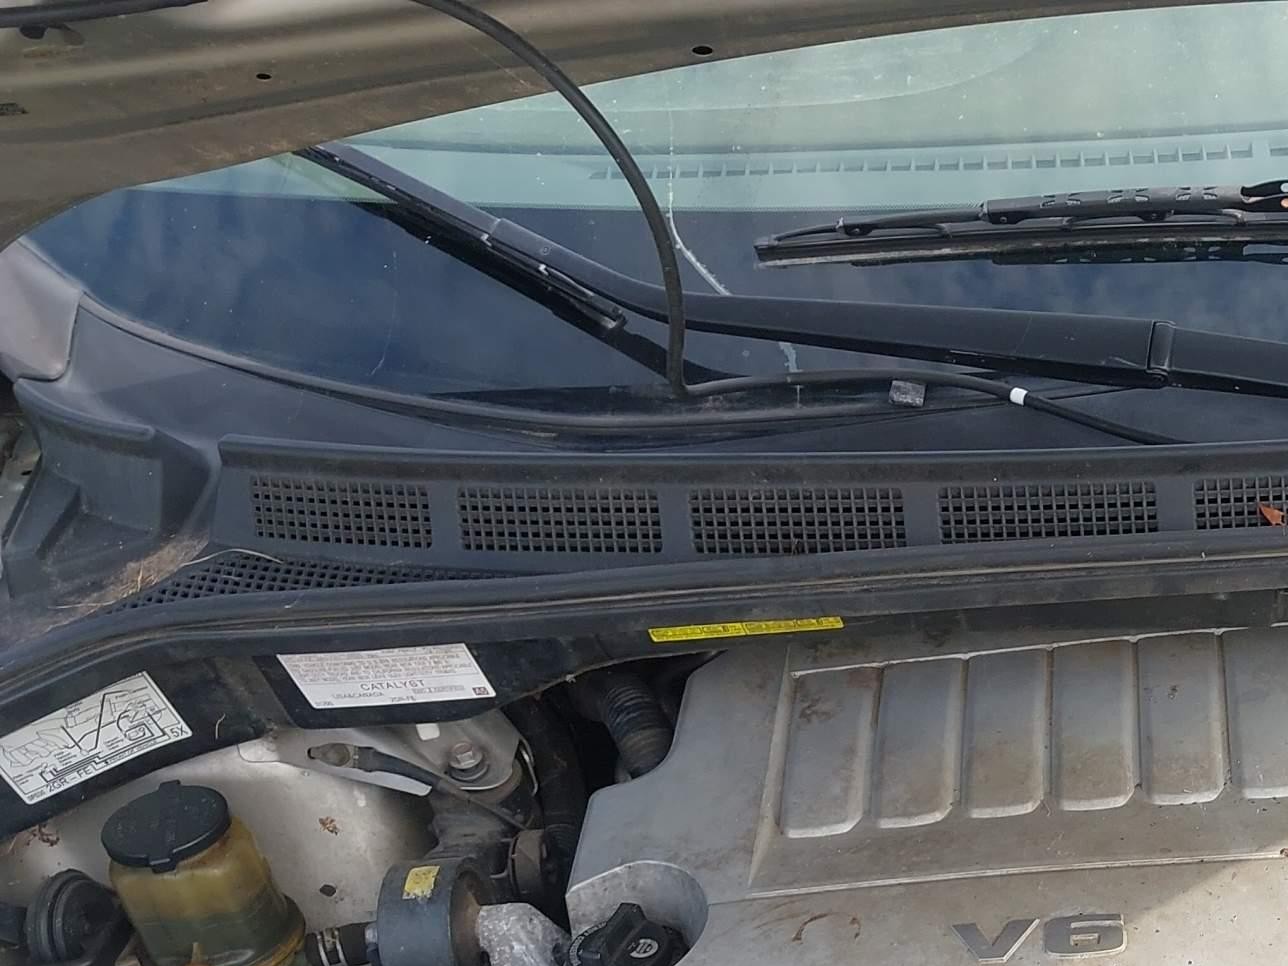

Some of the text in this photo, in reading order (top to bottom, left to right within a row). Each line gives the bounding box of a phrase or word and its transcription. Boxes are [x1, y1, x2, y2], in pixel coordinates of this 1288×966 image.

[360, 679, 425, 691] CATALYST
[170, 725, 188, 738] 5X
[951, 913, 1128, 963] V6
